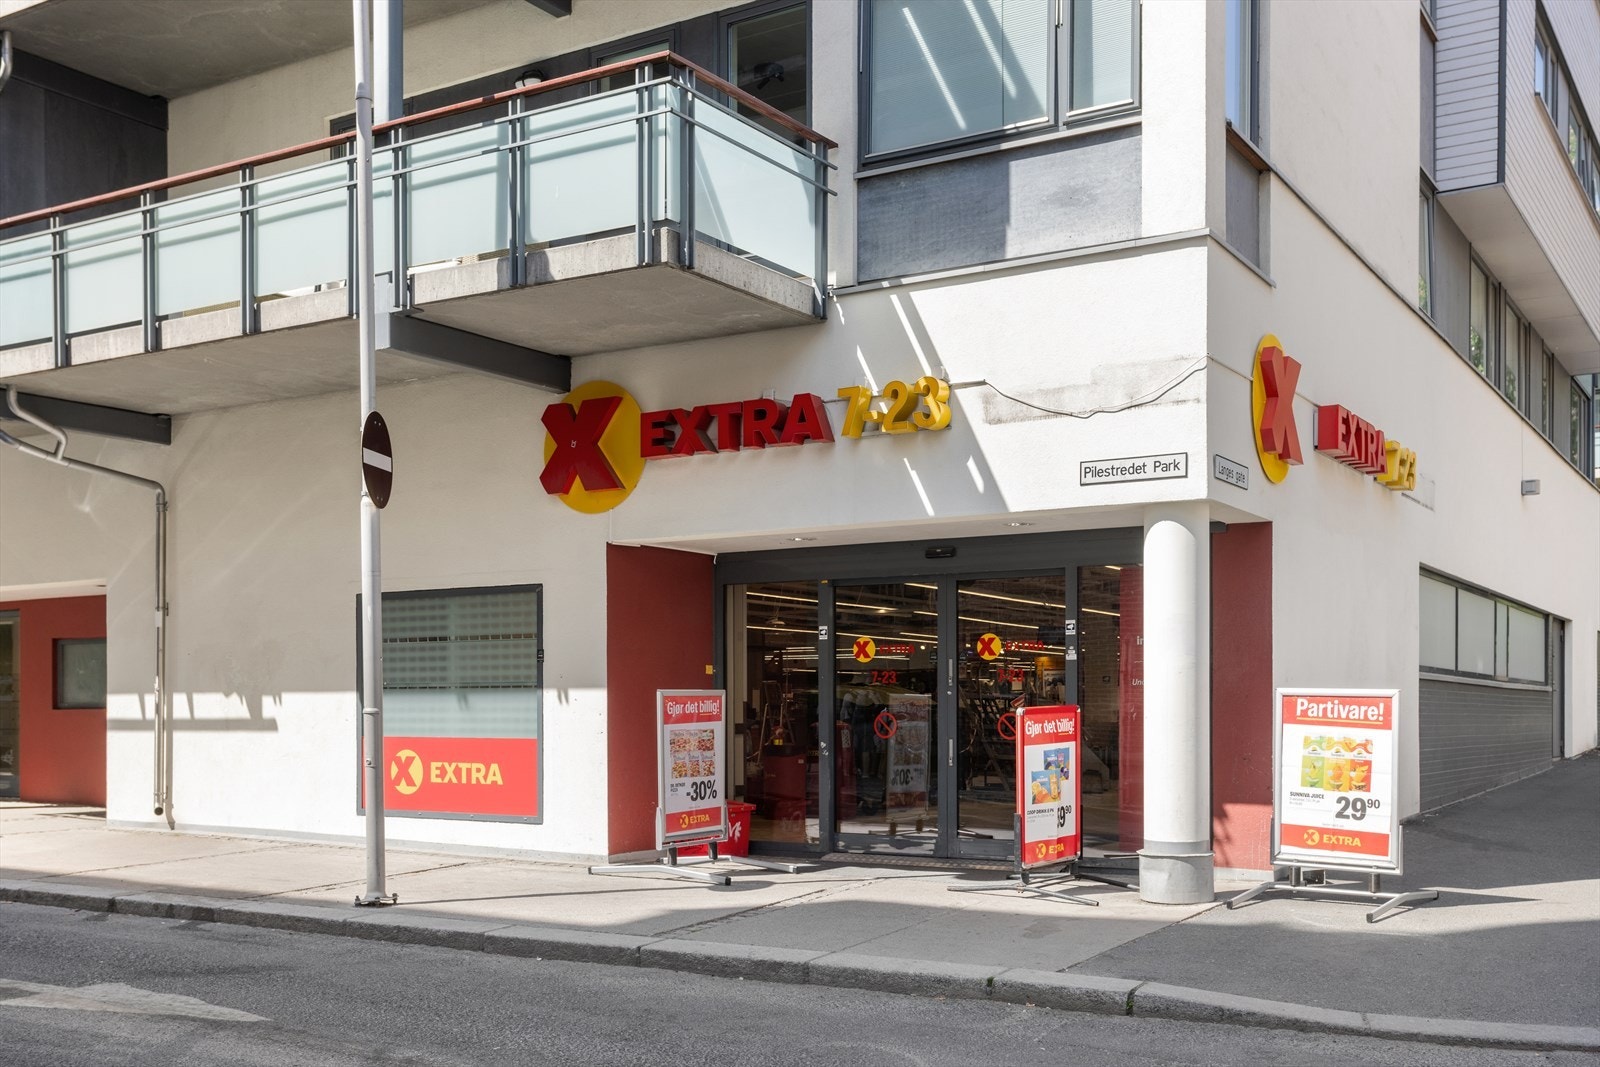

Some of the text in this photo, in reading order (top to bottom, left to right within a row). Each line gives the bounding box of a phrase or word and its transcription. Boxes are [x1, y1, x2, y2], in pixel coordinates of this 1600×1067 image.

[640, 392, 835, 460] EXTRA
[837, 376, 952, 439] 7-23
[1318, 404, 1388, 474] EXTRA
[1083, 459, 1181, 479] Pilestredet Park
[1218, 461, 1246, 484] Langes gate
[871, 670, 898, 685] 7-23
[667, 699, 720, 717] Gjør det billig!
[1296, 698, 1385, 722] Partivare!
[1025, 717, 1075, 738] Gjør det billig!
[430, 761, 504, 785] EXTRA
[686, 779, 718, 801] -30%
[690, 814, 711, 824] EXTRA
[1335, 796, 1381, 821] 29 90
[1323, 833, 1362, 847] EXTRA
